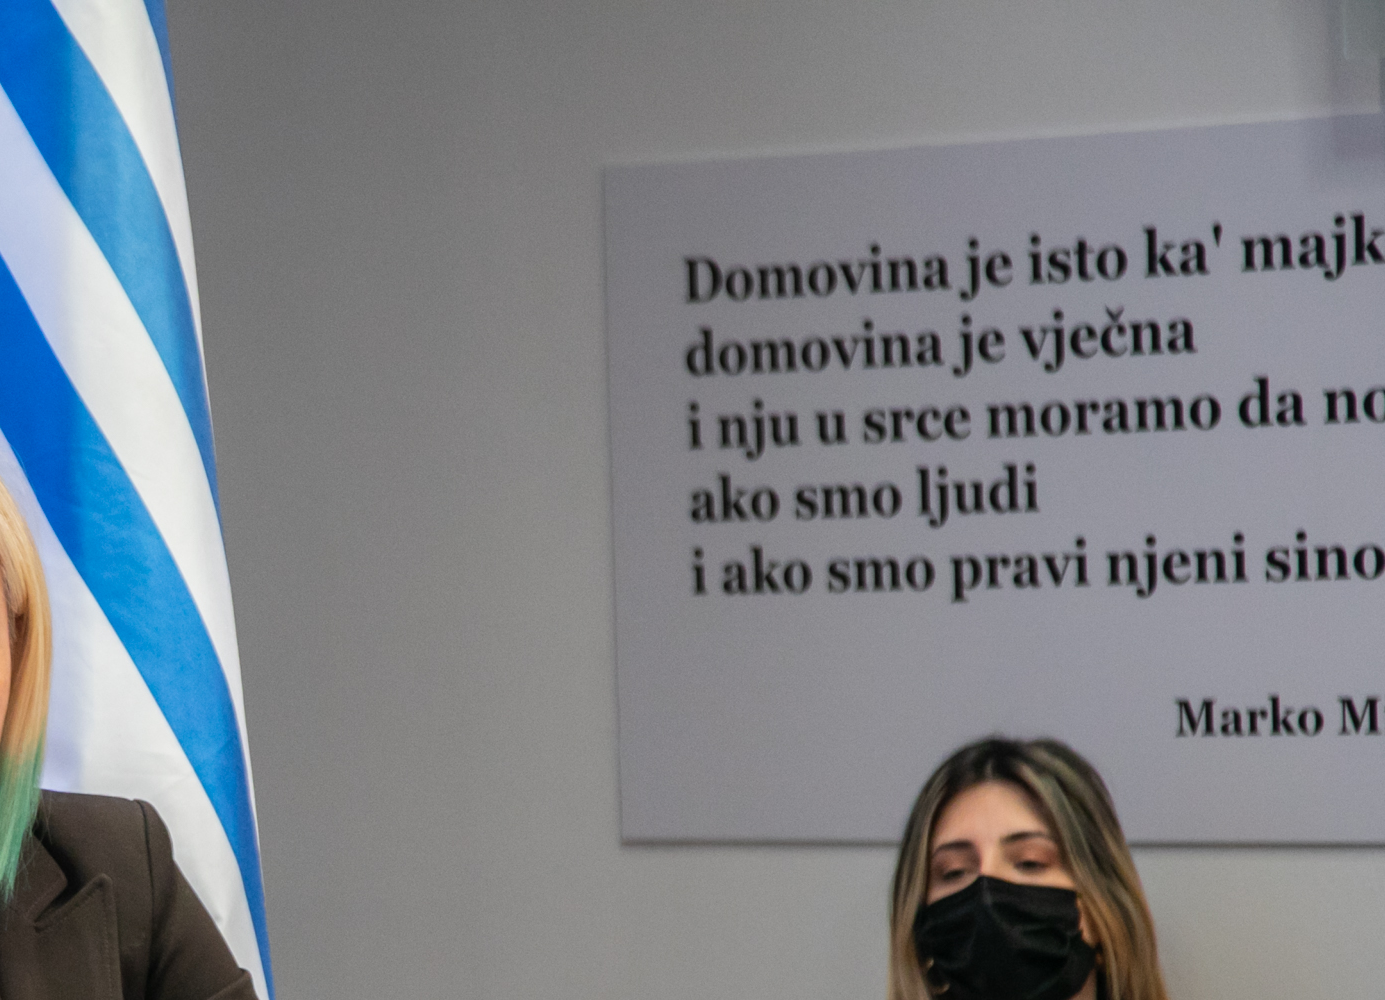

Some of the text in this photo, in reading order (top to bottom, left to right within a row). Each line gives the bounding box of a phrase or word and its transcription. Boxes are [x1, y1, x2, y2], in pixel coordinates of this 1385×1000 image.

[684, 211, 1385, 303] Domovina je isto ka' majk
[685, 304, 1198, 378] domovina je vječna
[688, 375, 1385, 461] i nju u srce moramo da no
[690, 461, 1040, 529] ako smo ljudi
[692, 528, 1385, 603] i ako smo pravi njeni sino
[1175, 693, 1325, 738] Marko
